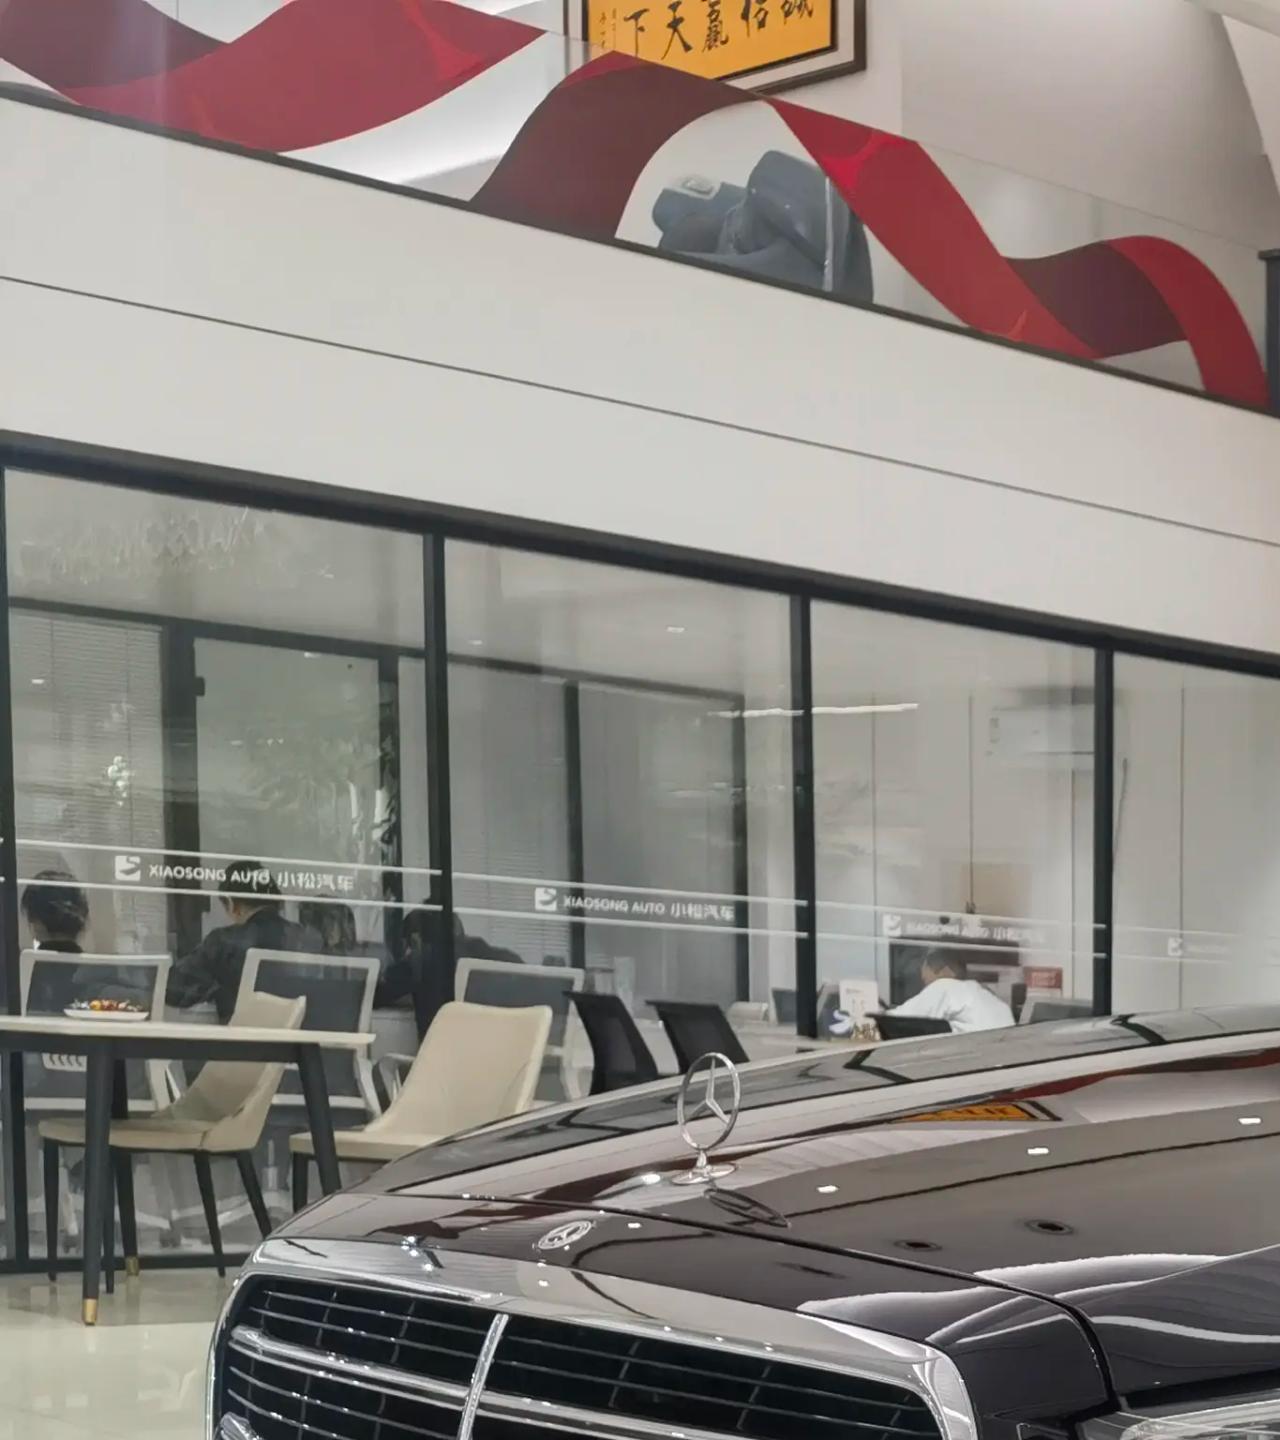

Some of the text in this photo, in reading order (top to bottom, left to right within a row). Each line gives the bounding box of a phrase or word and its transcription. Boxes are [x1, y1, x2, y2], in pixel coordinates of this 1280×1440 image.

[148, 864, 227, 882] XIAOSONG
[229, 869, 270, 886] AUTO
[562, 895, 628, 913] XIAOSONG
[631, 901, 665, 916] AUTO
